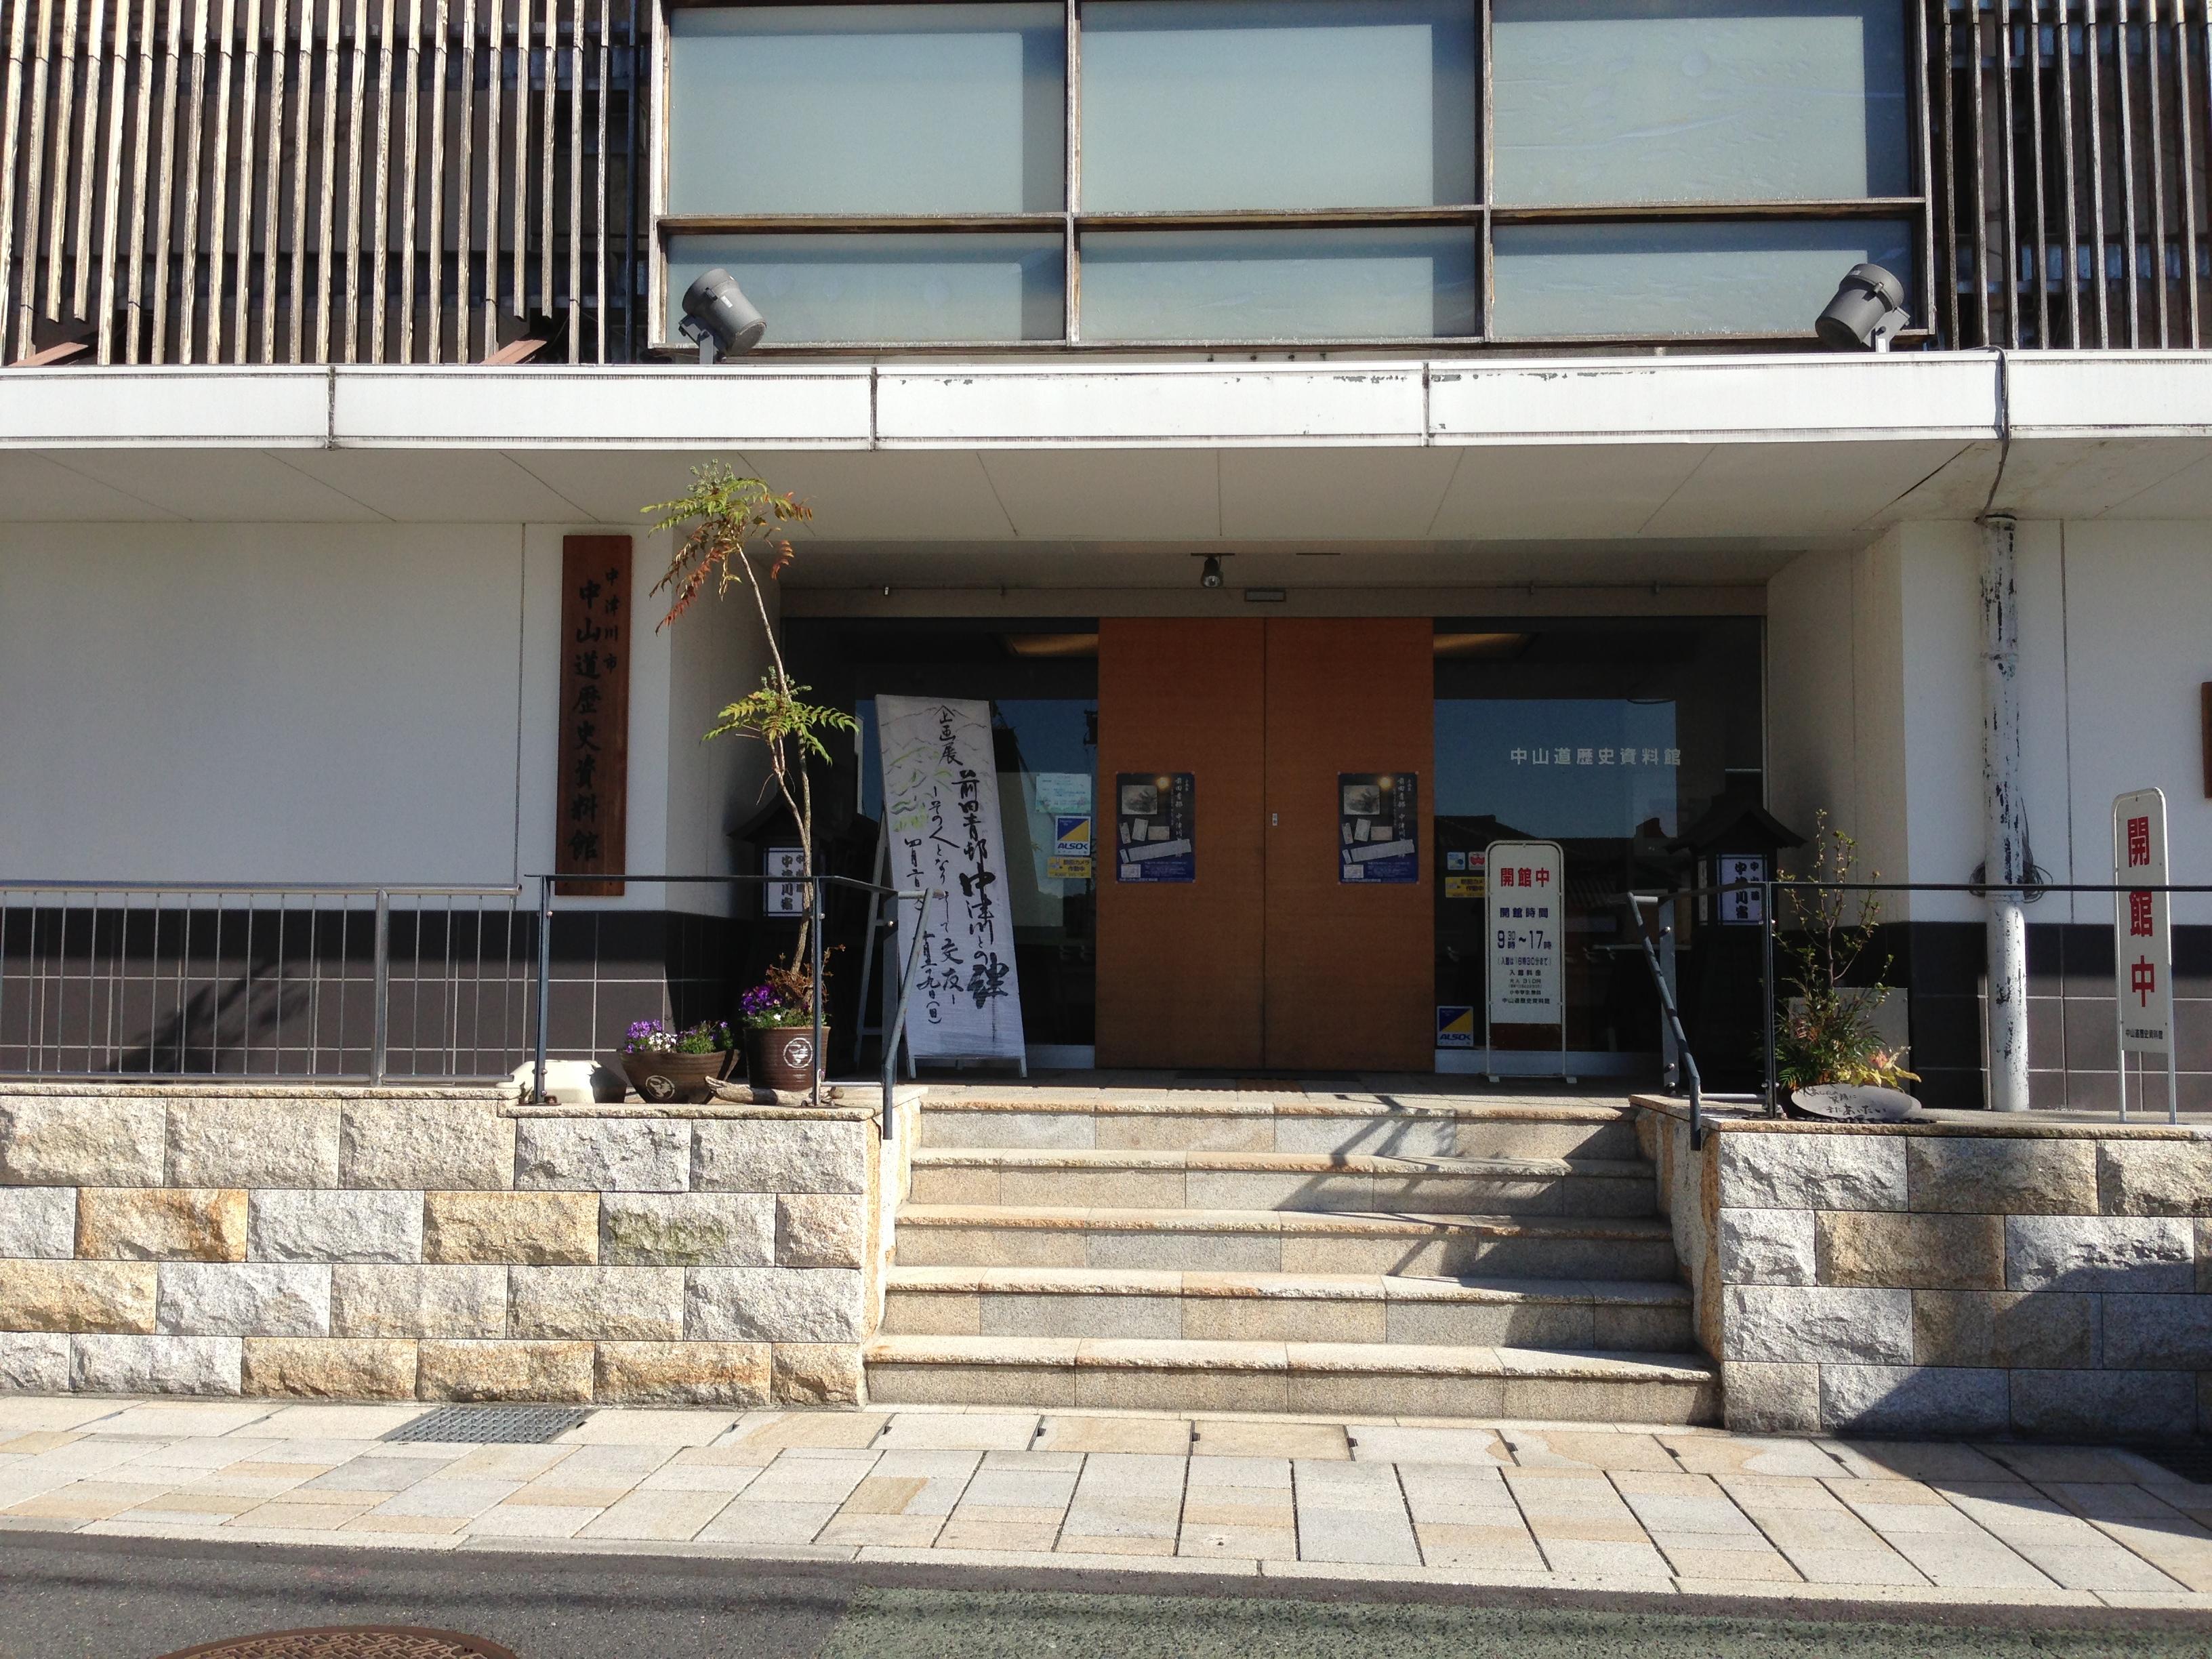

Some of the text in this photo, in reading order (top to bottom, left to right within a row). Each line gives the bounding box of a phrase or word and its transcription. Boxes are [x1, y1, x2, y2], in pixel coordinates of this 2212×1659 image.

[604, 567, 620, 674] 中津川市
[569, 579, 602, 861] 中山道歴史資料館
[1511, 747, 1681, 766] 中山道歴史資料館
[1500, 867, 1550, 888] 開館中
[1500, 907, 1549, 918] 開館時間
[2127, 816, 2154, 1008] 開館中
